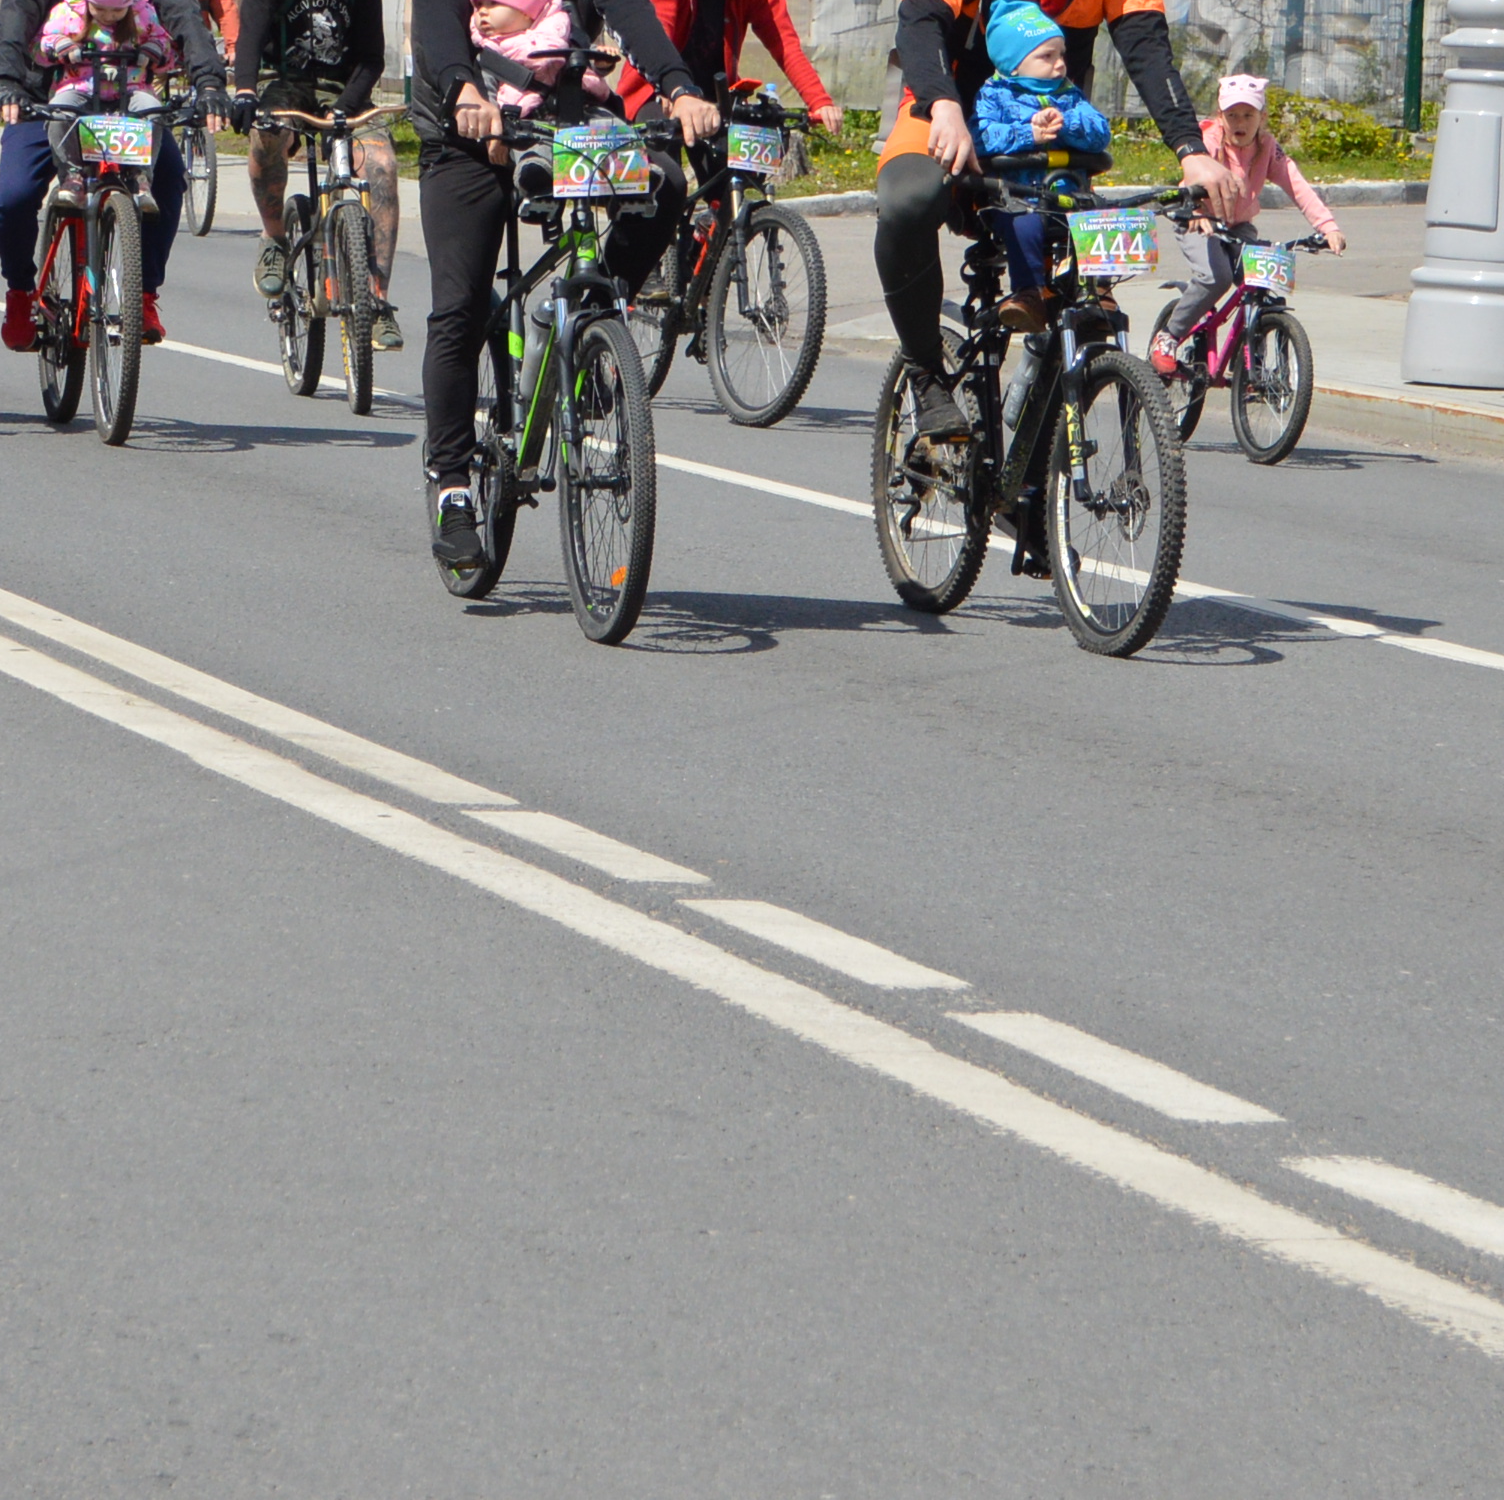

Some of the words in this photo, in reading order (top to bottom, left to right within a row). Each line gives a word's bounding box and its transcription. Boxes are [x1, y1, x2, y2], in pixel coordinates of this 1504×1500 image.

[94, 130, 139, 156] 552
[738, 141, 773, 166] 526
[569, 149, 636, 184] 607
[1089, 232, 1147, 263] 444
[1255, 260, 1288, 286] 525
